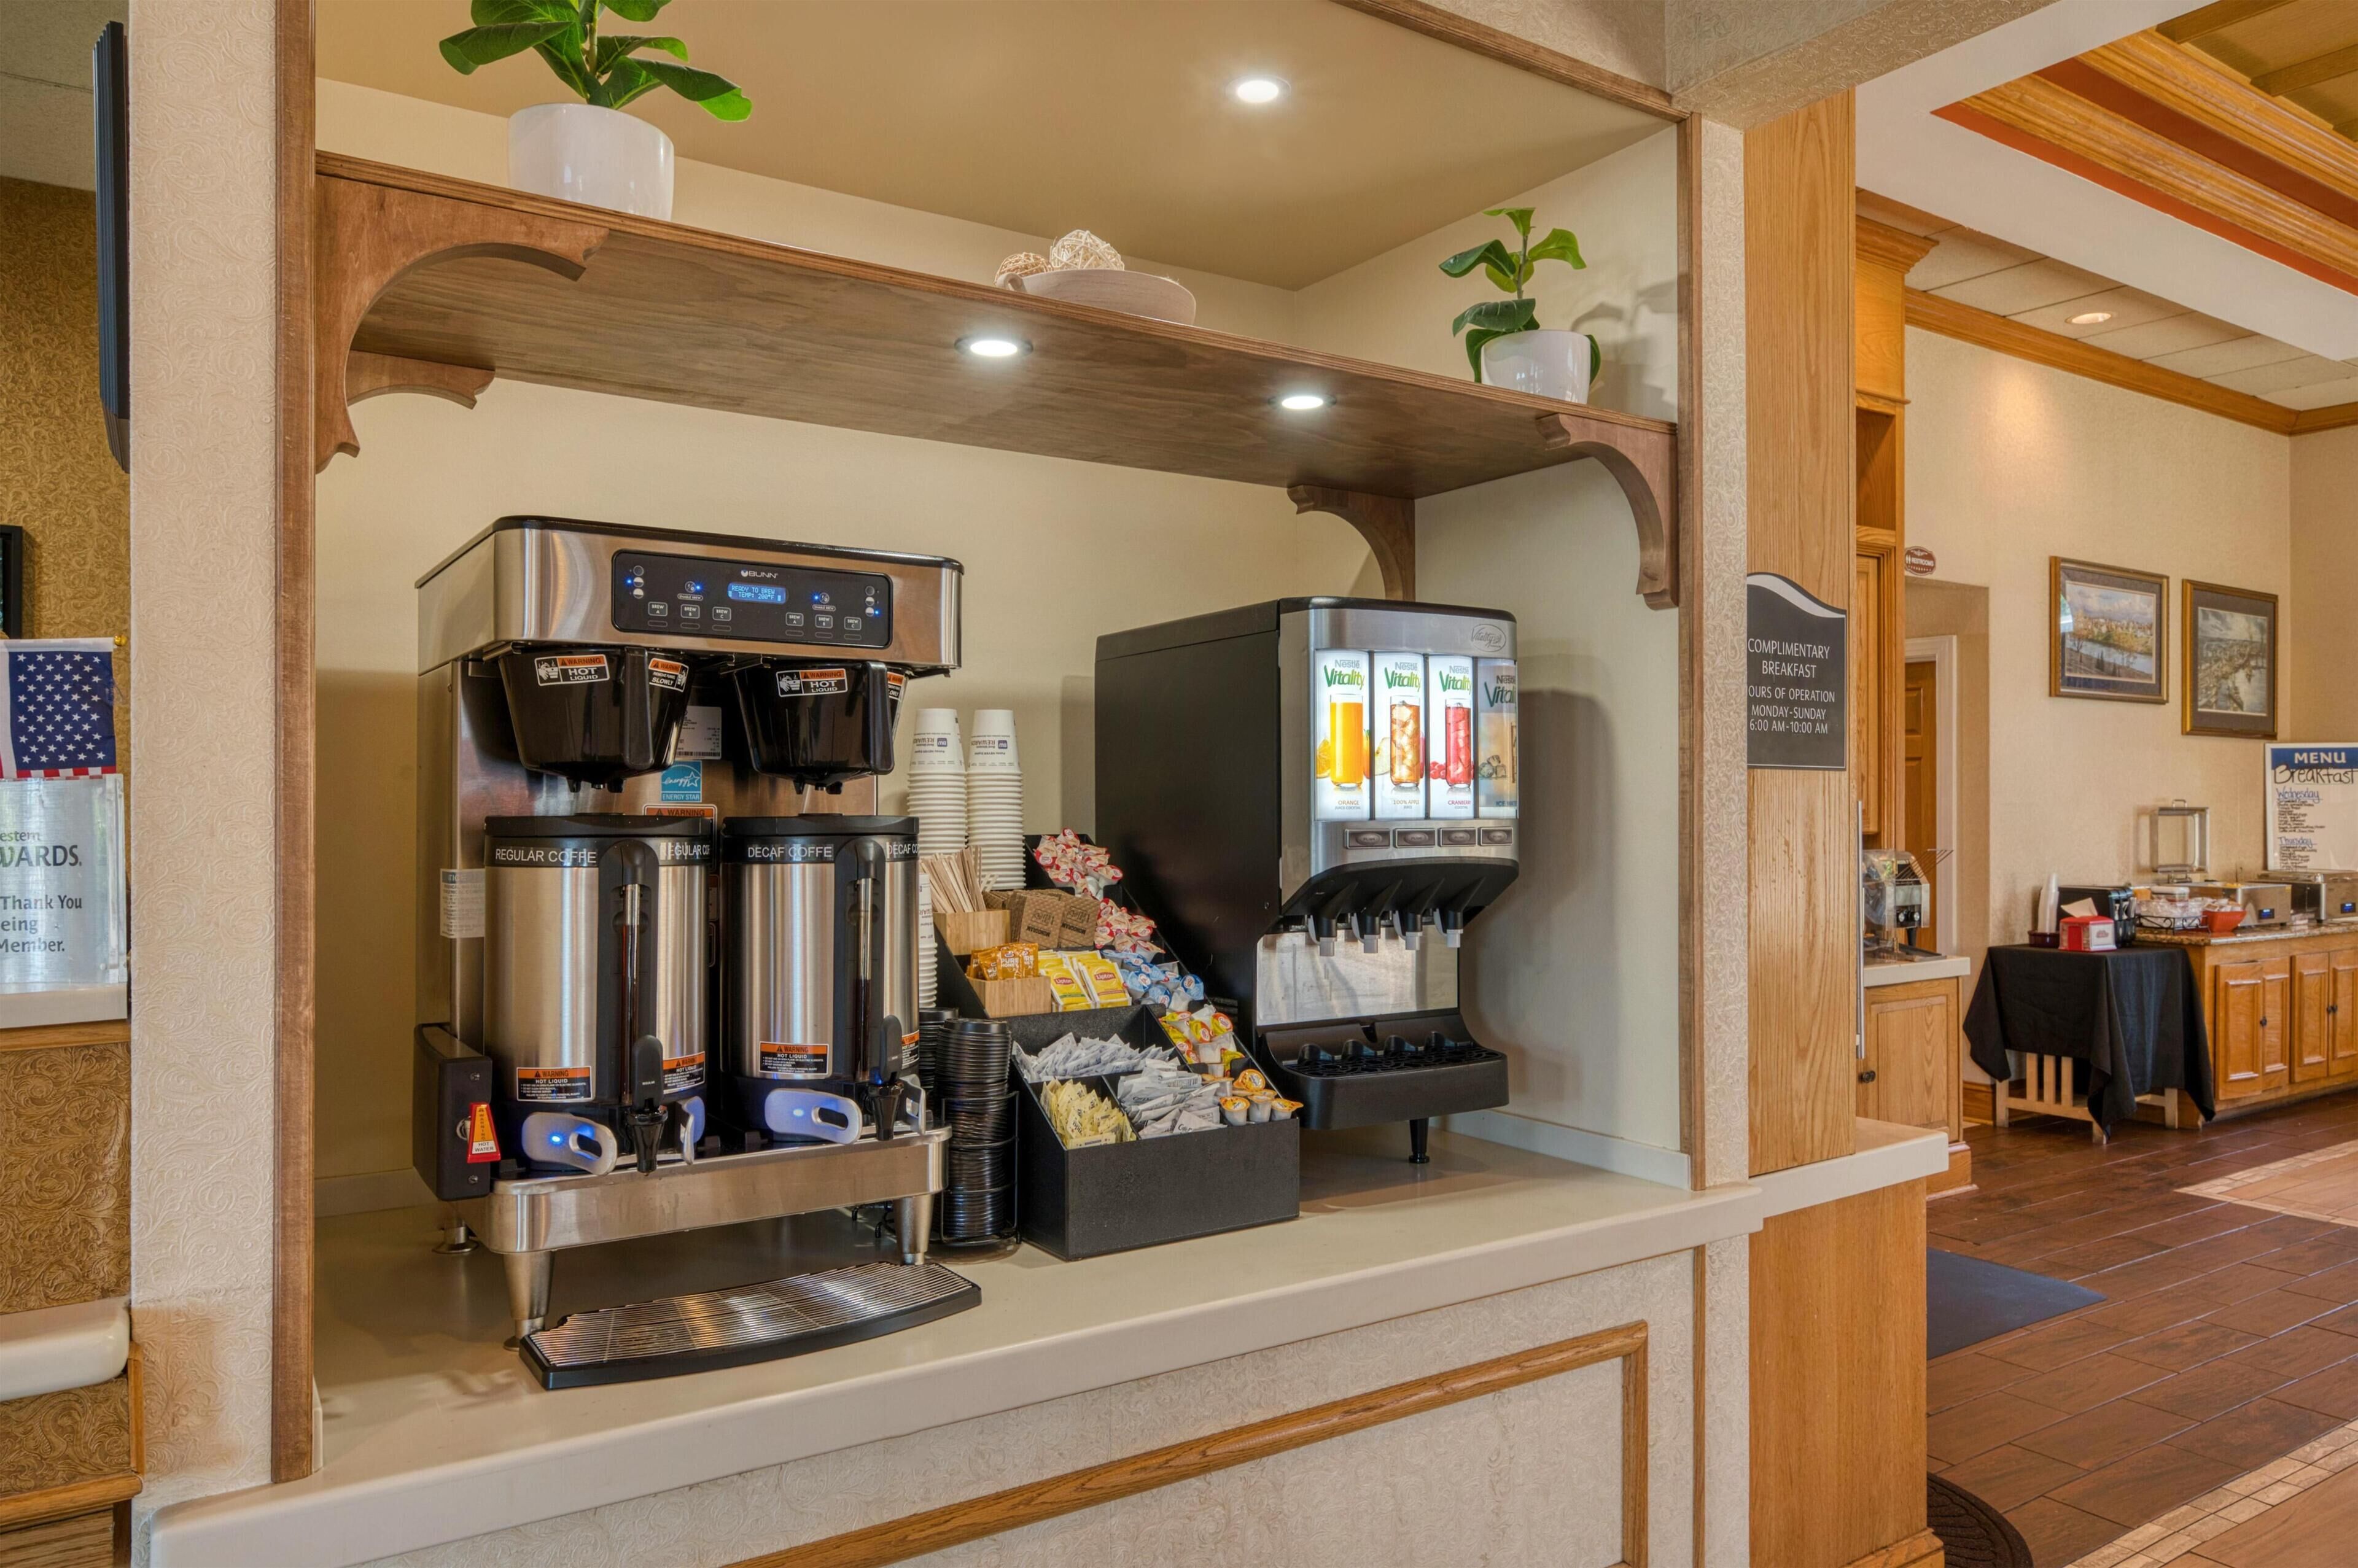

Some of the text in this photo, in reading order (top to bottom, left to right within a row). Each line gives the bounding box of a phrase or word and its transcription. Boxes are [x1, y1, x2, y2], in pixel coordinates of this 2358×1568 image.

[1748, 638, 1830, 659] COMPLIMENTARY
[1324, 665, 1365, 690] Vitality
[1762, 661, 1816, 678] BREAKFAST
[652, 677, 674, 686] SLOWLY
[1384, 667, 1421, 692] Vitality
[1439, 670, 1471, 695] Vitality
[1748, 685, 1835, 702] OURS OF OPERATION
[1751, 705, 1826, 720] MONDAY-SUNDAY
[1749, 719, 1828, 734] 6:00 AM-10:00 AM
[2294, 751, 2346, 764] MENU
[2273, 764, 2357, 784] Breakfast
[2276, 786, 2321, 804] Wednesday
[495, 848, 597, 863] REGULAR COFFE
[748, 847, 833, 858] DECAF COFFE
[887, 844, 911, 855] DECAF
[0, 895, 82, 910] Thank You
[1, 917, 38, 934] eing
